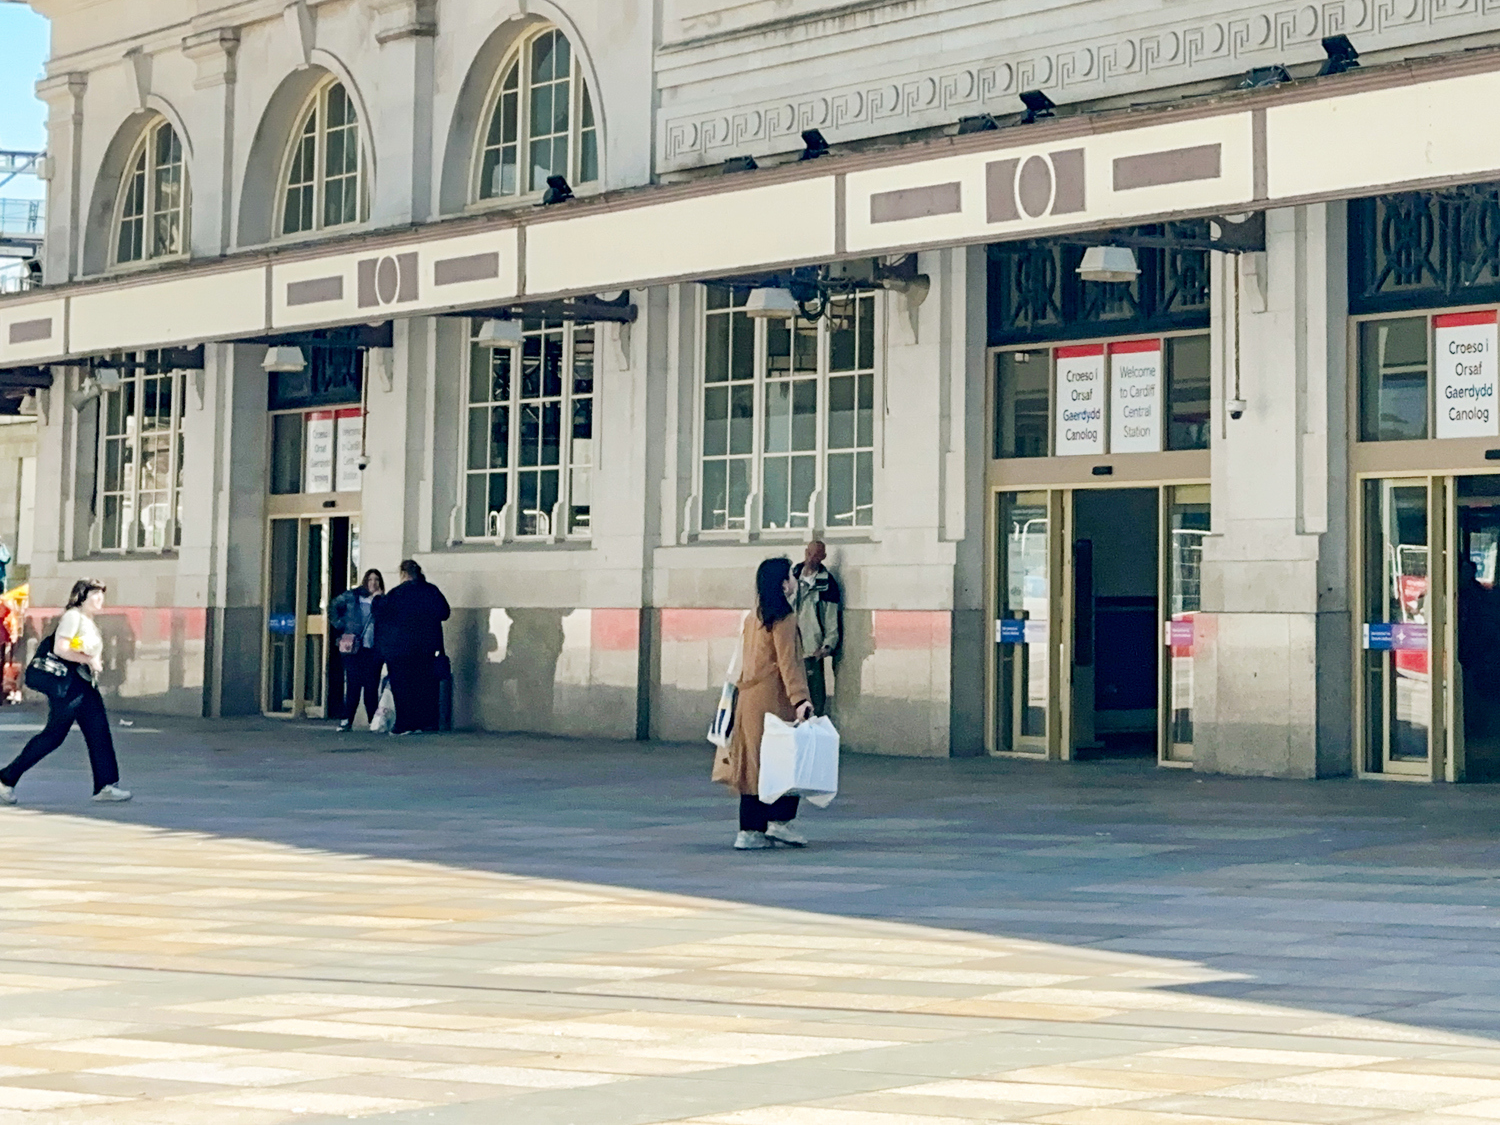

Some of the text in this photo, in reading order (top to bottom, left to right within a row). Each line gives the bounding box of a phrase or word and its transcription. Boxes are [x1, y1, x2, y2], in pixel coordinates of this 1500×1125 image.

[1448, 340, 1484, 355] Croeso
[1120, 365, 1156, 378] Welcome
[1455, 361, 1482, 376] Orsaf
[1066, 370, 1094, 383] Croeso
[1071, 388, 1093, 401] Orsaf
[1129, 384, 1156, 398] Cardiff
[1445, 383, 1493, 401] Gaerdydd
[1062, 408, 1101, 423] Gaerdydd
[1123, 404, 1151, 418] Central
[1448, 406, 1489, 423] Canolog
[1065, 428, 1098, 442] Canolog
[1123, 425, 1151, 438] Station
